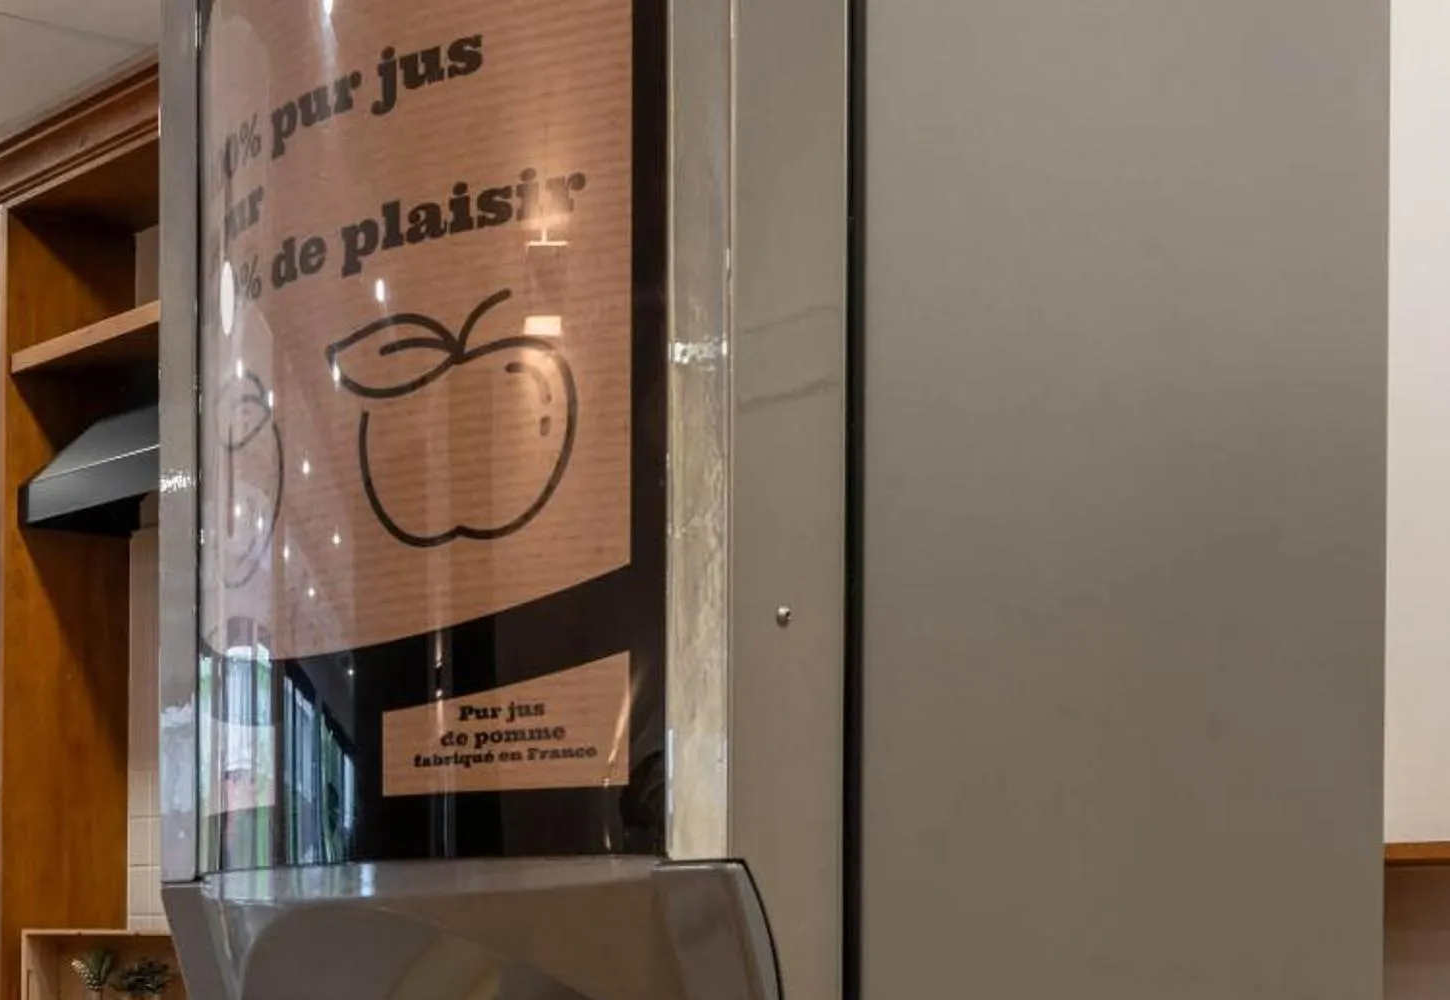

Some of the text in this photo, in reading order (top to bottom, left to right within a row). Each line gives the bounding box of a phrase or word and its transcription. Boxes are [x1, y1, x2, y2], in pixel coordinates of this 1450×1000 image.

[270, 68, 362, 159] pur
[371, 33, 484, 116] jus
[271, 236, 327, 289] de
[340, 167, 587, 277] plaisir
[459, 701, 545, 722] Pur jus
[440, 724, 565, 749] de pomme
[413, 744, 597, 768] fabriqué en France
